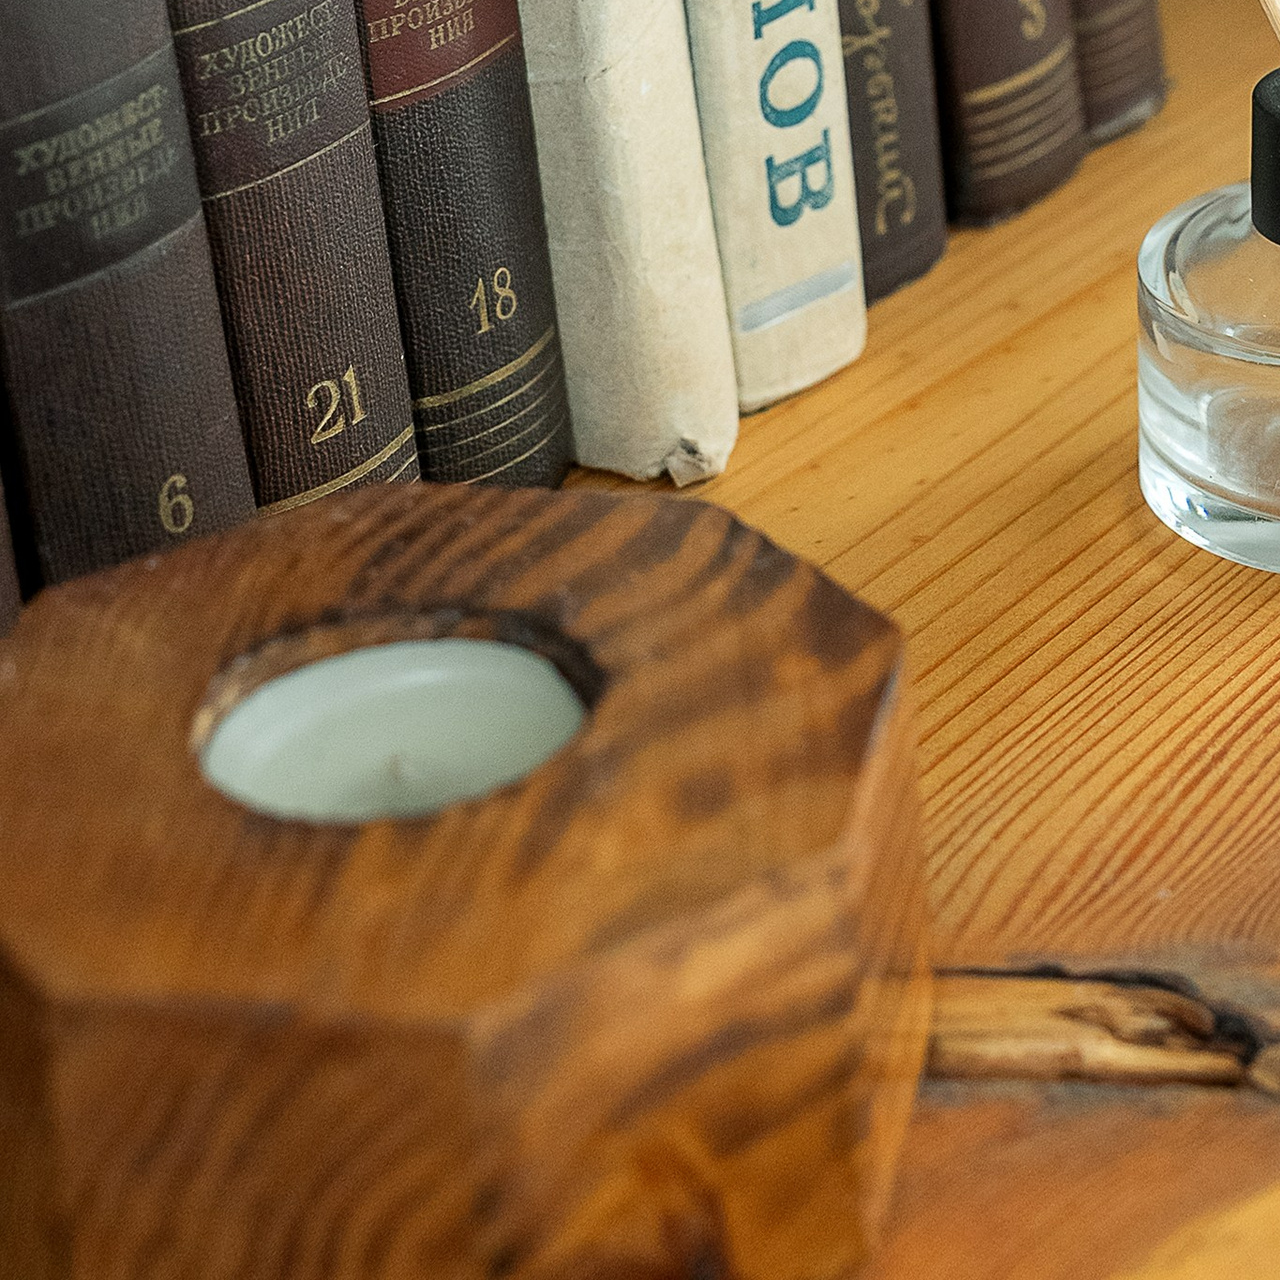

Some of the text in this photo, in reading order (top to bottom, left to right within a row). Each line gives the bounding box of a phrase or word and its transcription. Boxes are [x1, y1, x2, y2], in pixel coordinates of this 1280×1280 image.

[470, 267, 519, 335] 18
[306, 364, 370, 445] 21
[158, 473, 194, 535] 6
